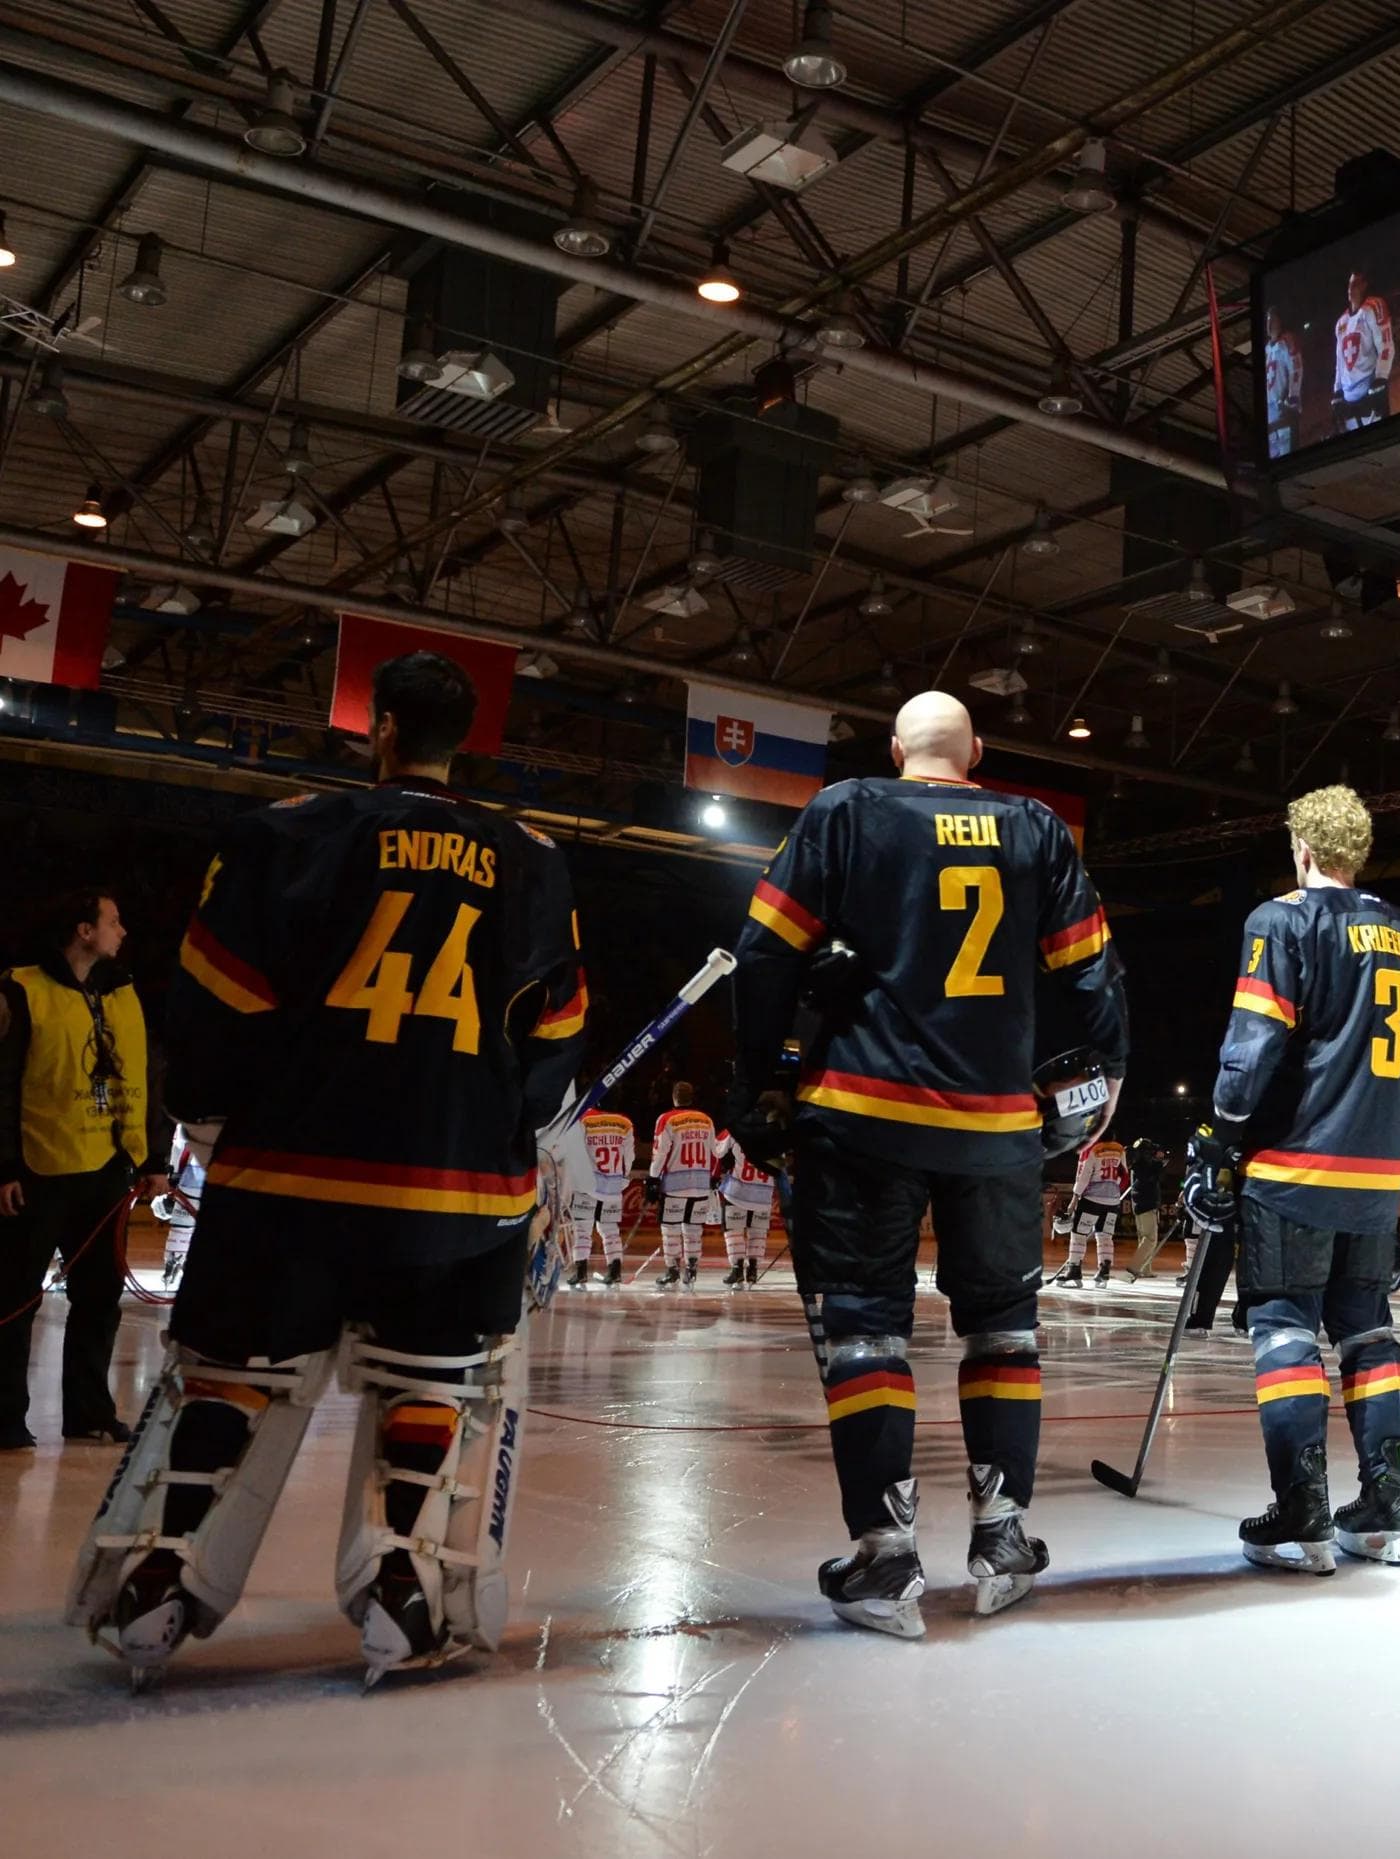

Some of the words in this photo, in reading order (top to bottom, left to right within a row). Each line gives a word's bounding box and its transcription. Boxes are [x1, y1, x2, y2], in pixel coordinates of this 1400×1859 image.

[934, 813, 1001, 847] REUL
[377, 830, 497, 889] ENDRAS
[938, 865, 1006, 998] 2
[322, 889, 484, 1056] 44
[595, 1146, 621, 1174] 27
[680, 1141, 707, 1169] 44
